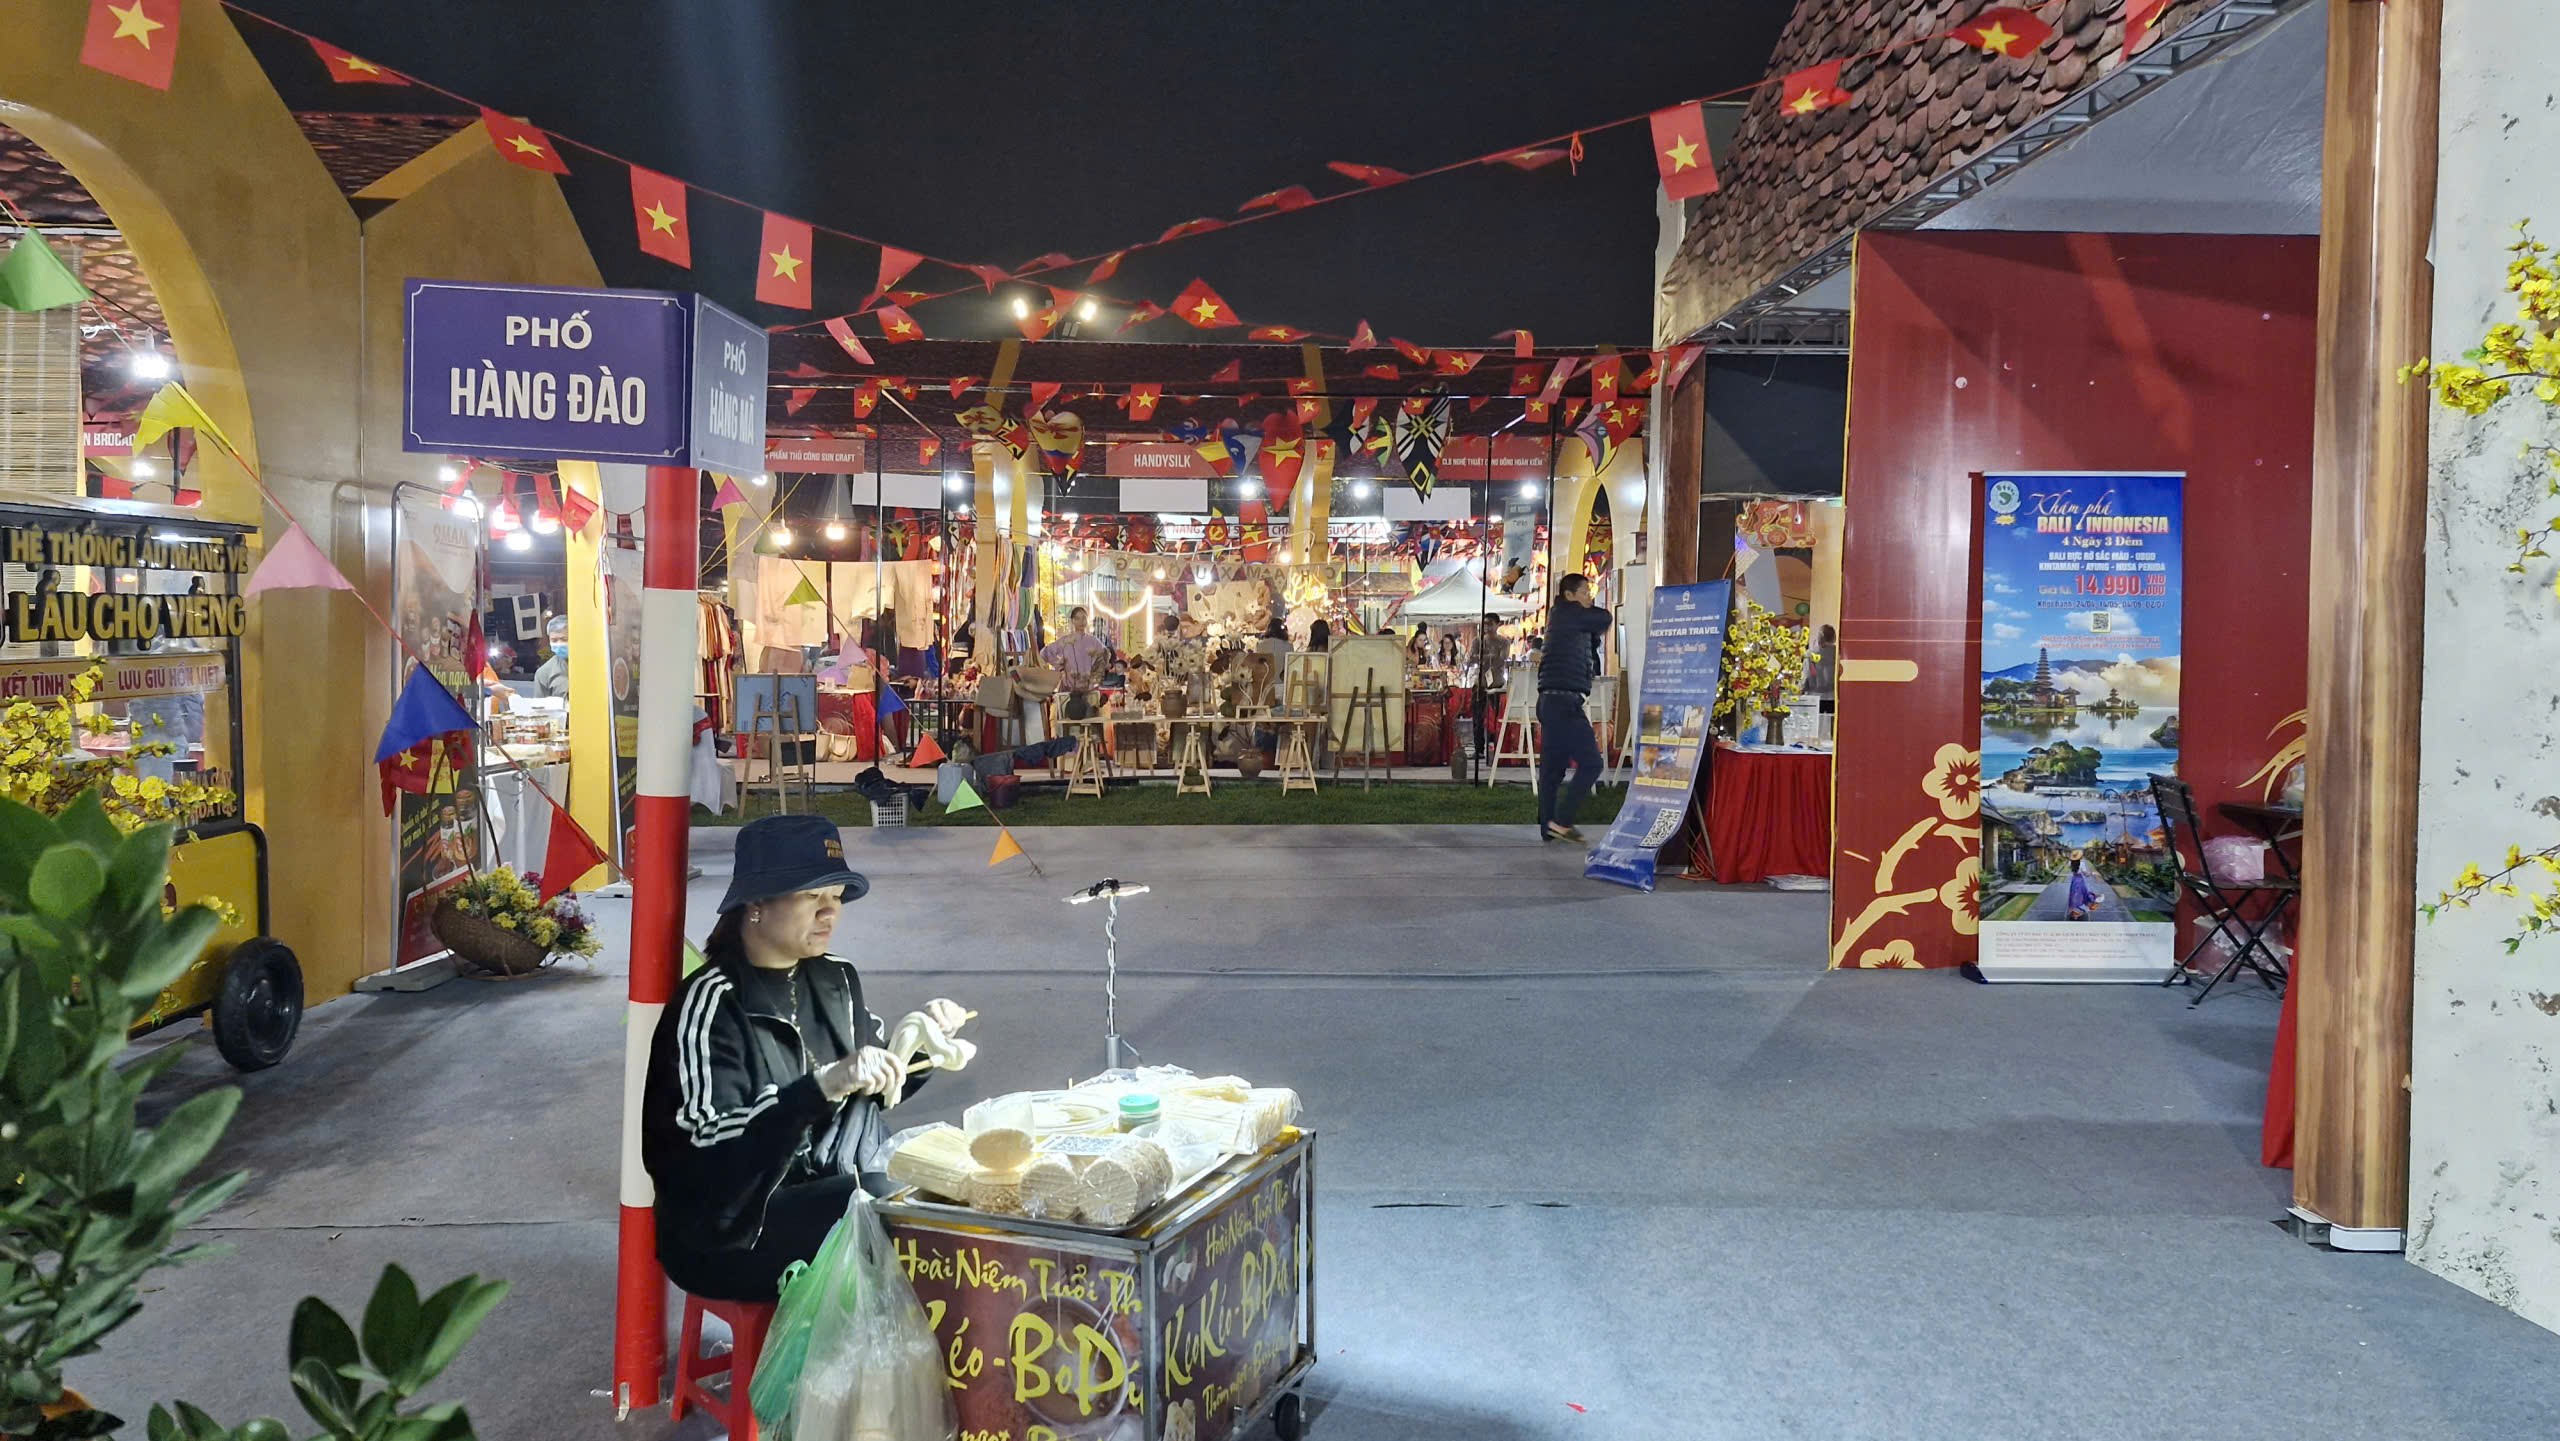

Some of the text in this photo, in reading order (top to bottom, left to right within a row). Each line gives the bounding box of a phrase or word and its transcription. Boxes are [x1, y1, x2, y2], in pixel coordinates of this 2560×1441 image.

[506, 310, 593, 350] PHỐ
[724, 340, 747, 377] PHỐ
[450, 358, 646, 426] HÀNG ĐÀO
[709, 382, 755, 445] HÀNG MÃ
[93, 432, 136, 446] BROCAD
[821, 452, 834, 462] SUN
[835, 453, 856, 462] CRAFT
[1134, 454, 1191, 468] HANDYSILK
[2024, 489, 2116, 531] Khám phá
[2037, 516, 2169, 534] BALI INDONESIA
[2062, 536, 2143, 548] 4 Ngày 3 Đêm
[2048, 551, 2065, 561] BALI
[93, 595, 162, 651] CHỢ
[1650, 626, 1720, 637] NEXTSTAR TRAVEL
[31, 671, 65, 697] TÌNH
[954, 1247, 1027, 1302] Niệm
[1029, 1257, 1098, 1302] Tuổi
